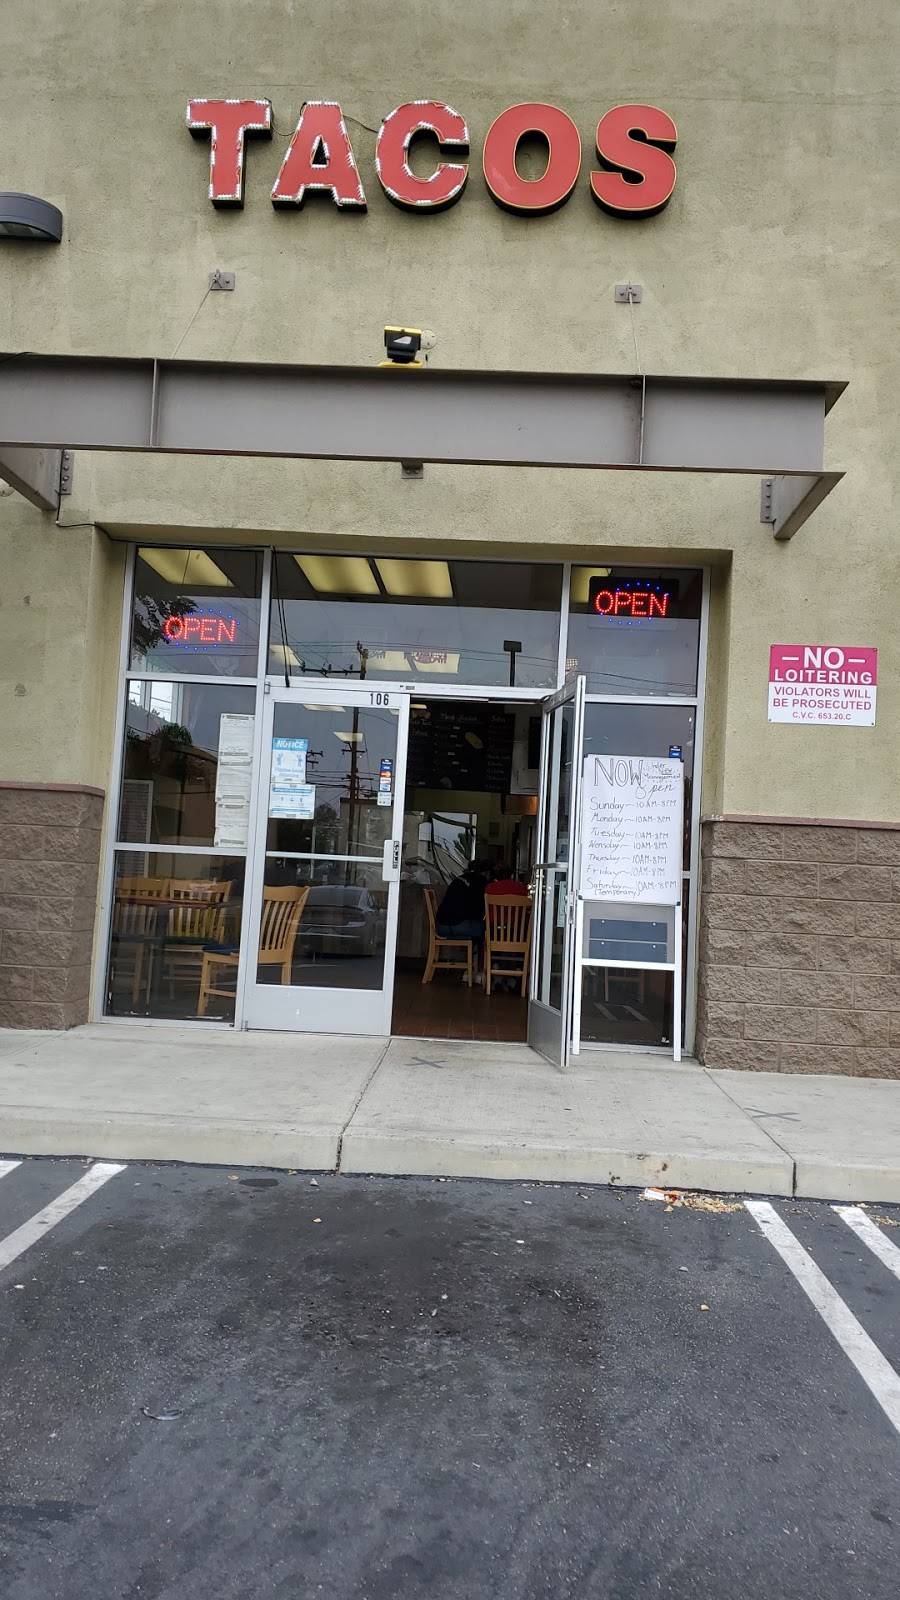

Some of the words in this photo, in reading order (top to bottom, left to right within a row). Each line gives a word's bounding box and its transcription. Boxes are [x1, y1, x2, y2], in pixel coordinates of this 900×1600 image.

[187, 99, 678, 214] TACOS
[595, 591, 668, 616] OPEN
[164, 616, 237, 642] OPEN
[803, 647, 845, 669] NO
[774, 669, 873, 684] LOITERING
[370, 693, 390, 706] 106
[774, 686, 840, 698] VIOLATORS
[843, 688, 871, 699] WILL
[773, 698, 789, 708] BE
[792, 699, 872, 711] PROSECUTED
[277, 741, 305, 749] NOTICE
[593, 758, 643, 787] NOW
[590, 797, 625, 814] Sunday
[591, 813, 623, 828] Monday
[591, 827, 625, 842] Tuesday
[586, 864, 620, 878] Friday
[586, 877, 621, 890] Saturday
